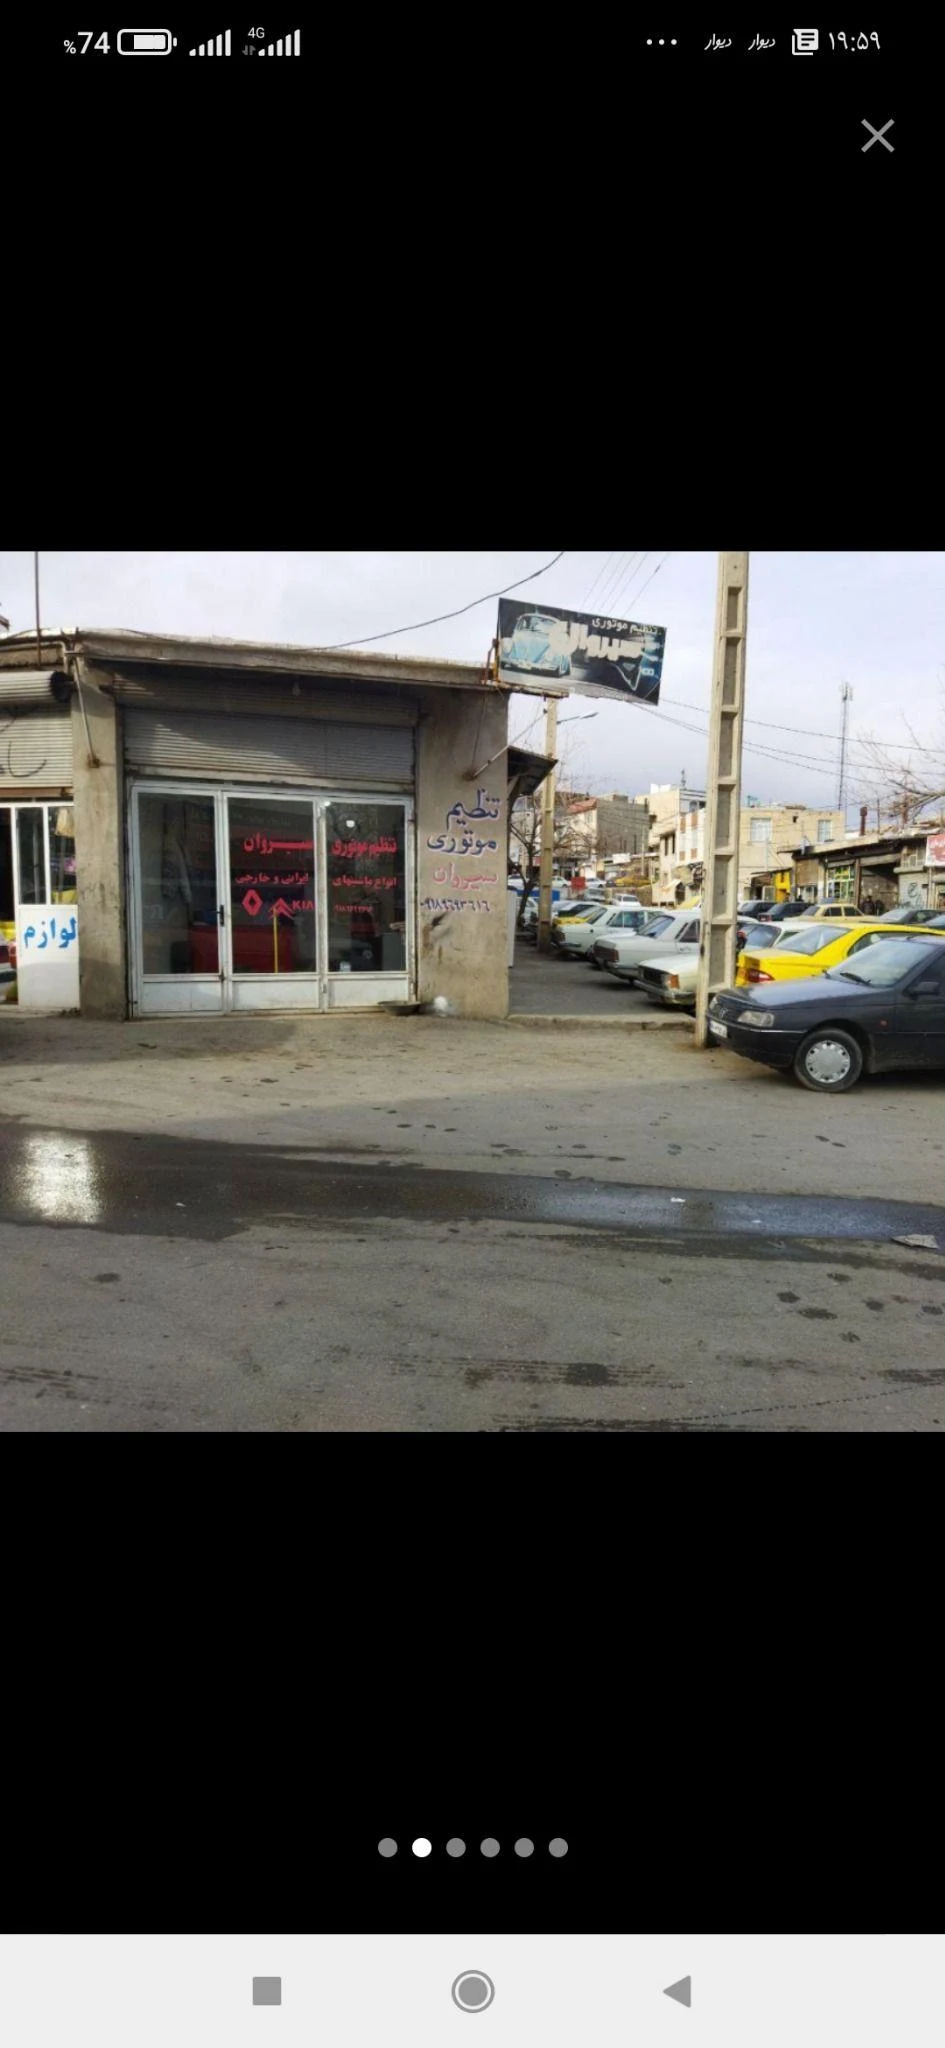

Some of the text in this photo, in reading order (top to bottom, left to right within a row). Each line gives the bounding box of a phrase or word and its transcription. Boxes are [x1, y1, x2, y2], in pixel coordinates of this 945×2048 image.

[591, 617, 628, 631] موتوری
[447, 787, 501, 830] تنظیم
[426, 829, 499, 856] موتوری
[432, 862, 499, 890] سیروان
[23, 916, 77, 949] لوازم
